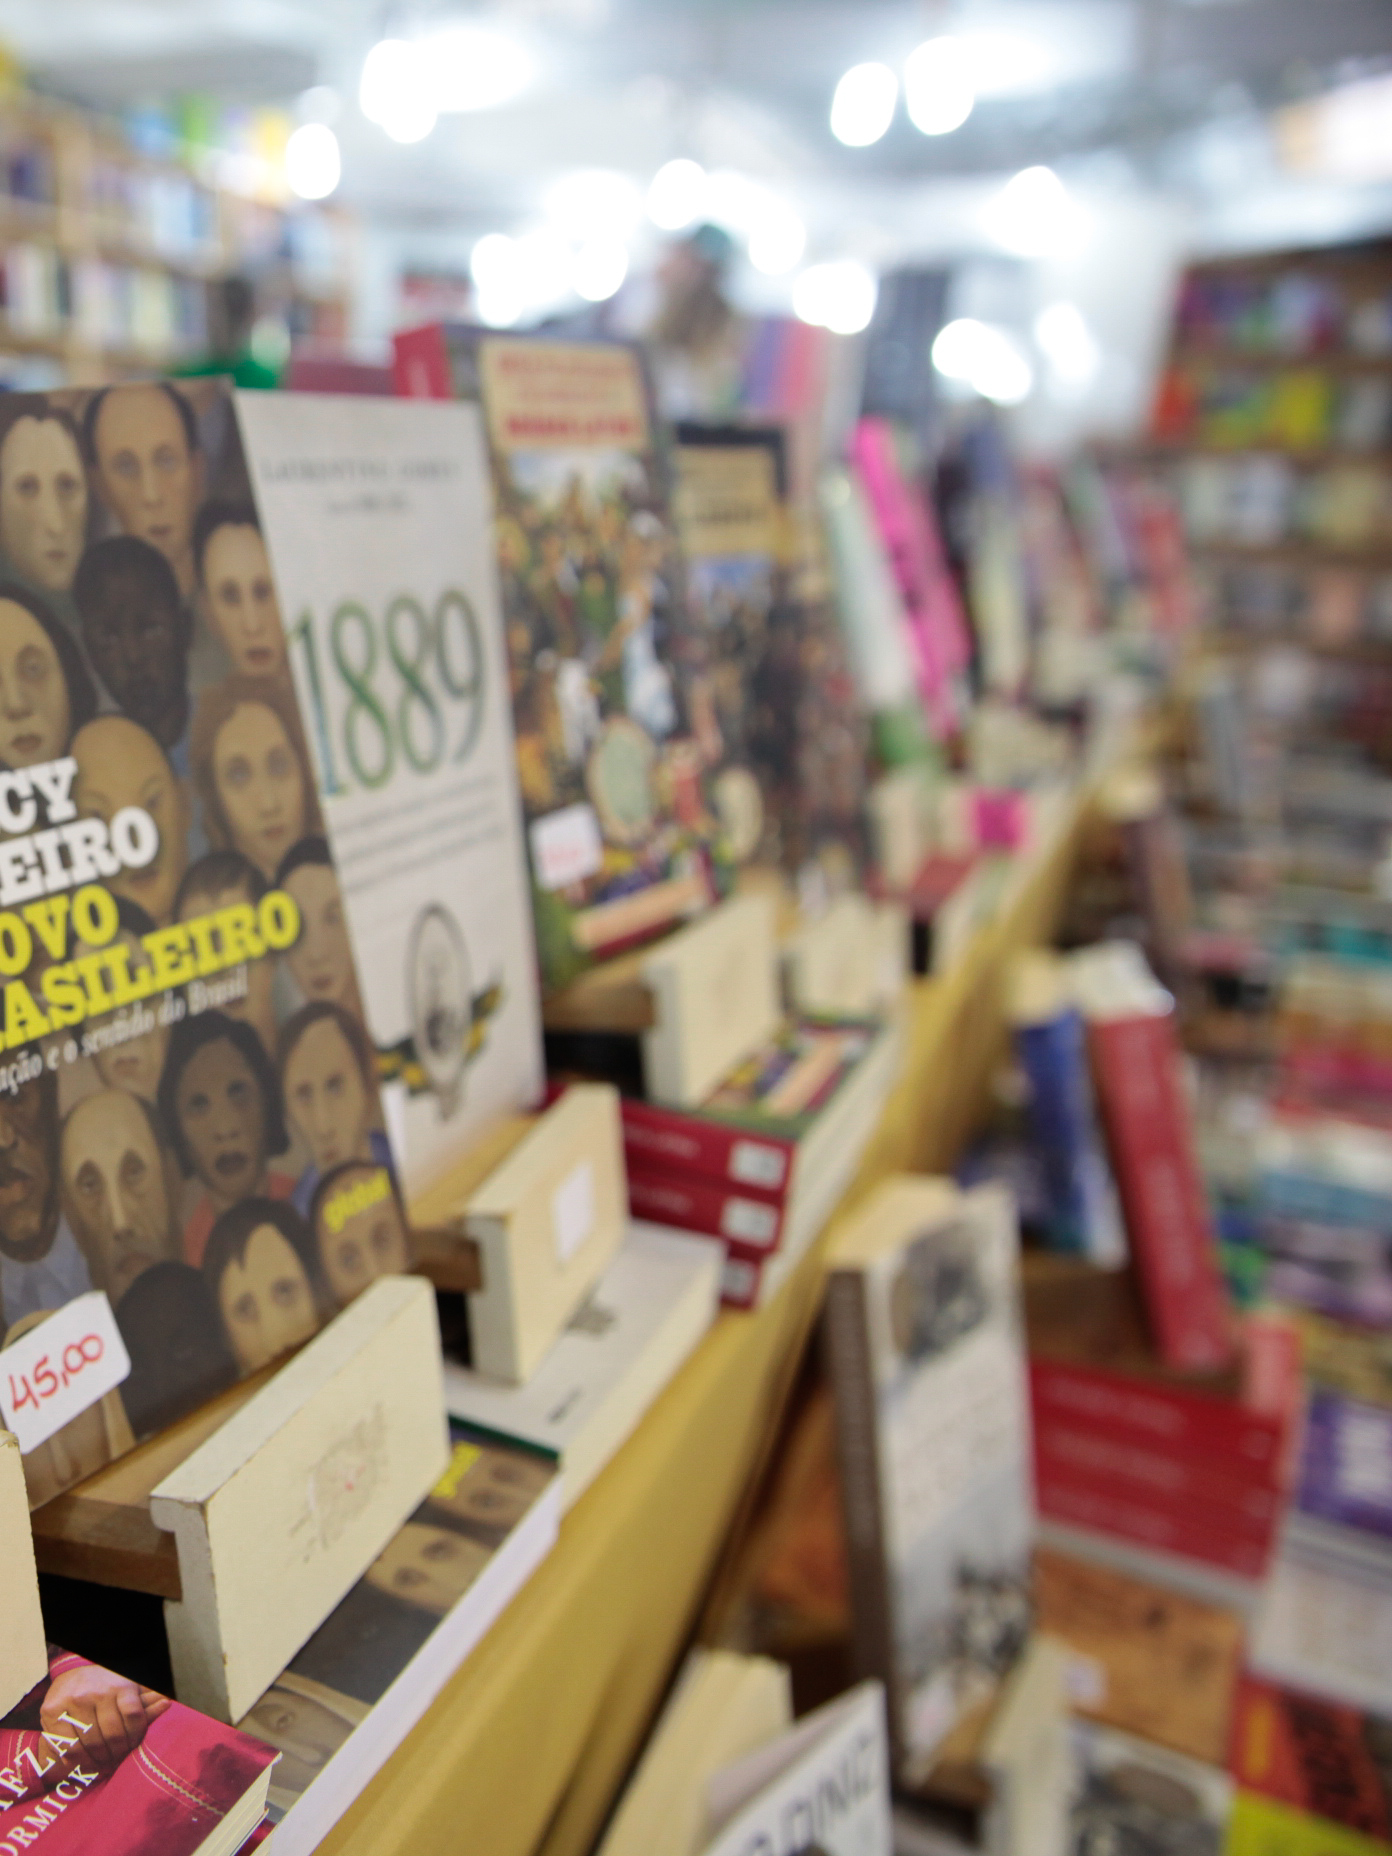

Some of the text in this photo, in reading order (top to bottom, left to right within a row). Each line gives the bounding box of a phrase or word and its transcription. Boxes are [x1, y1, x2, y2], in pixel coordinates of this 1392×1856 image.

[288, 586, 490, 799] 1889
[45, 1045, 61, 1072] e
[62, 1038, 79, 1065] o
[186, 961, 249, 1018] Brasil
[8, 1331, 105, 1413] 45,00
